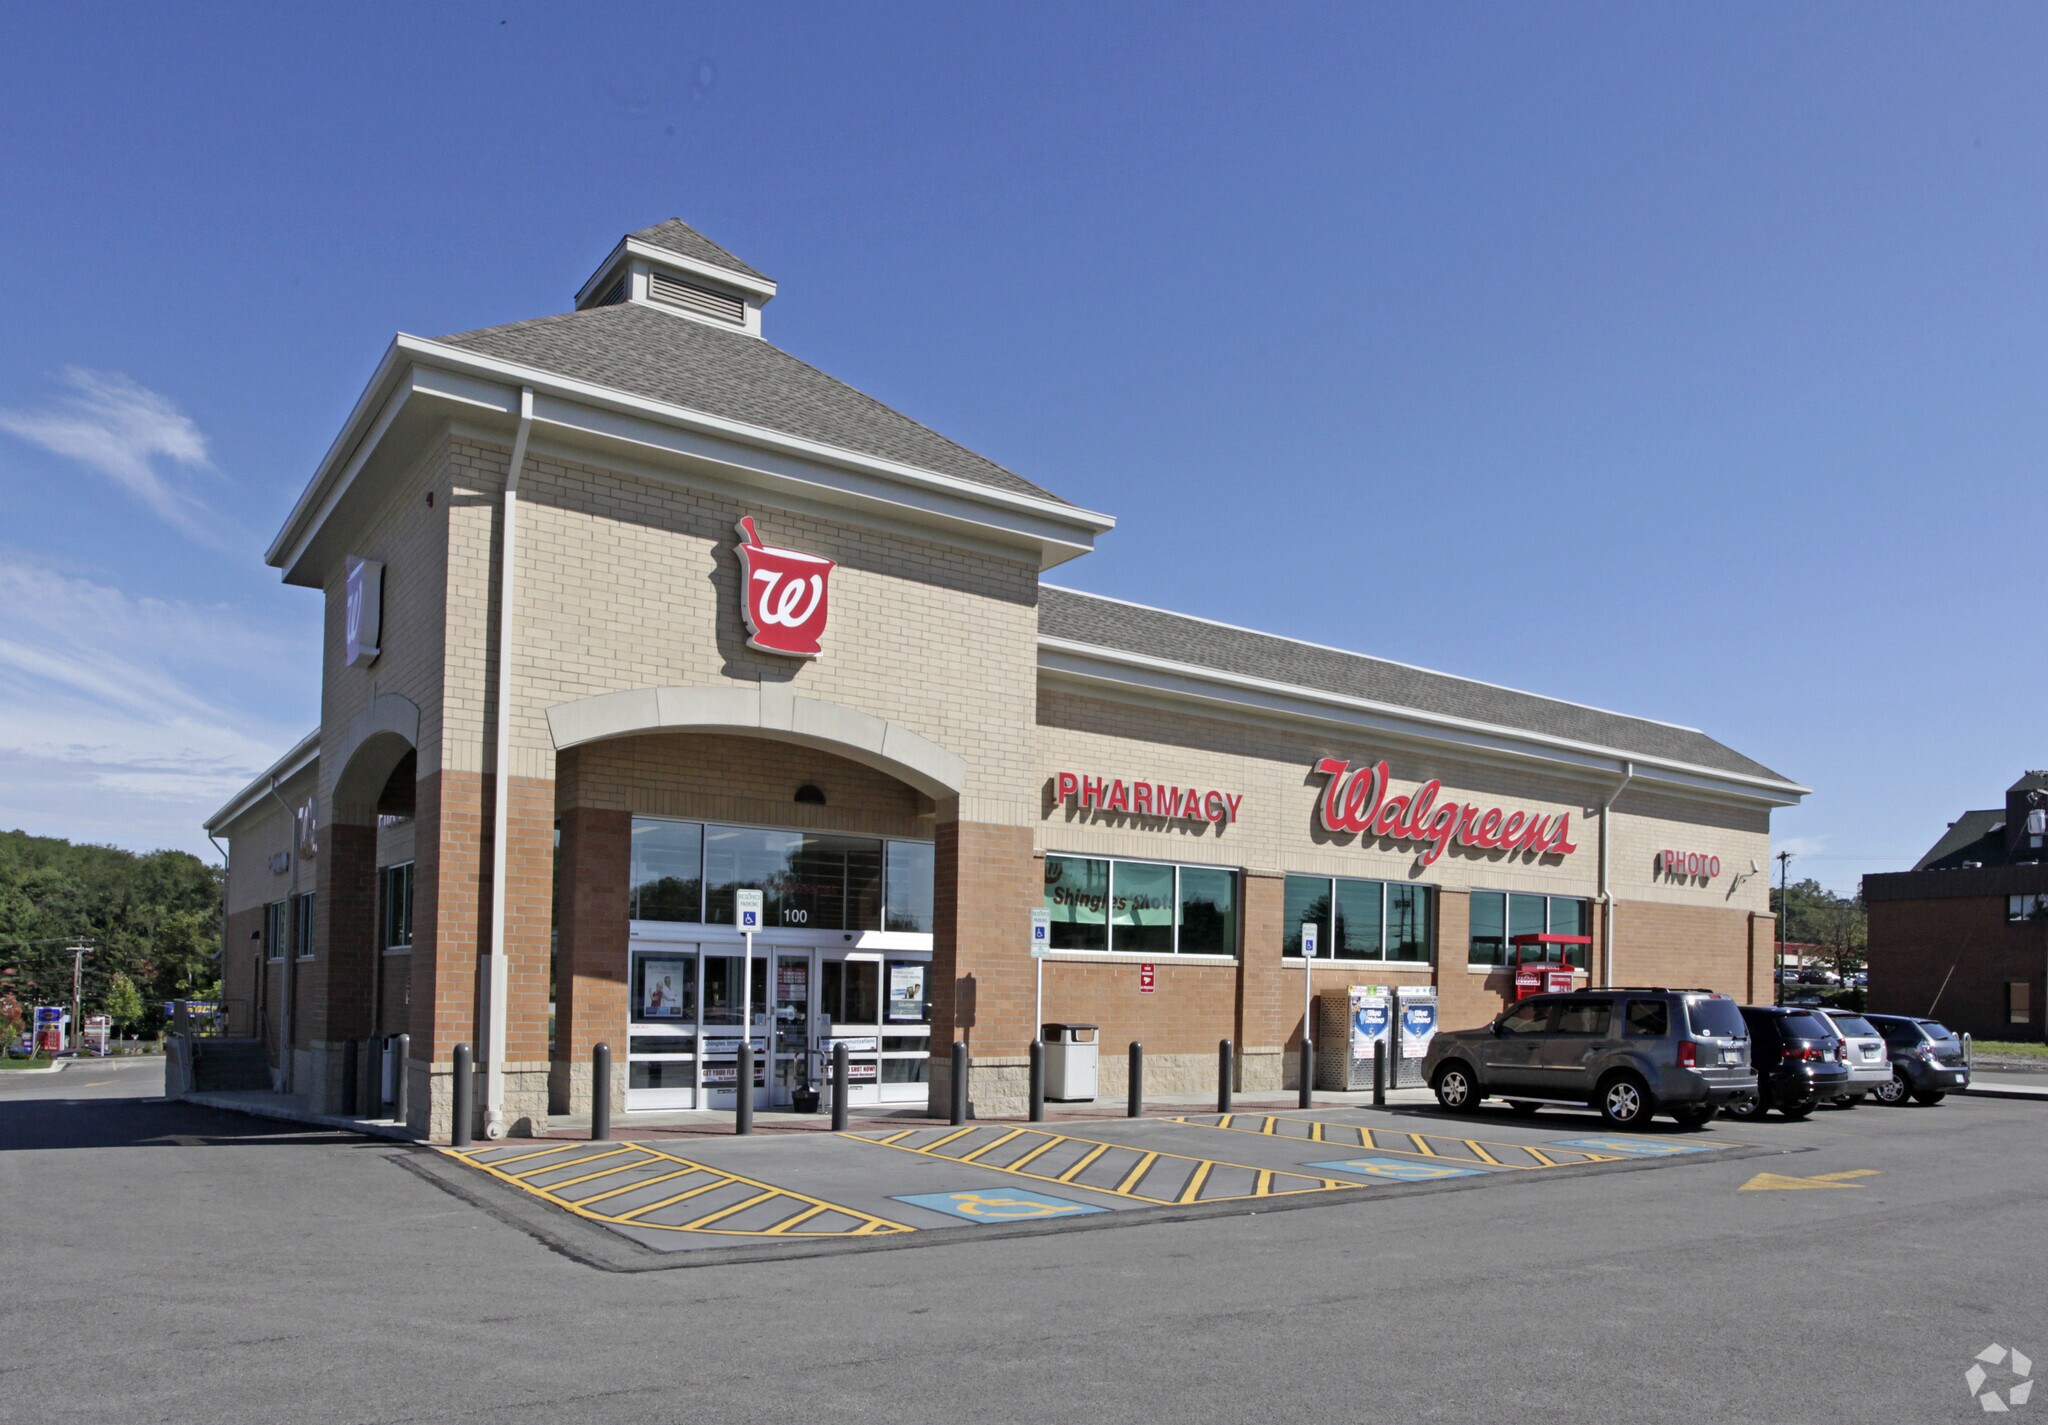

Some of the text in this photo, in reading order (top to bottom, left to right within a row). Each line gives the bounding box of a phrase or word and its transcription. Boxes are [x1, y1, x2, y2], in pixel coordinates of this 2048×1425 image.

[753, 568, 822, 628] W
[1053, 771, 1243, 825] PHARMACY
[1314, 757, 1578, 867] Walgreens
[1662, 849, 1721, 878] PHOTO
[783, 908, 808, 924] 100
